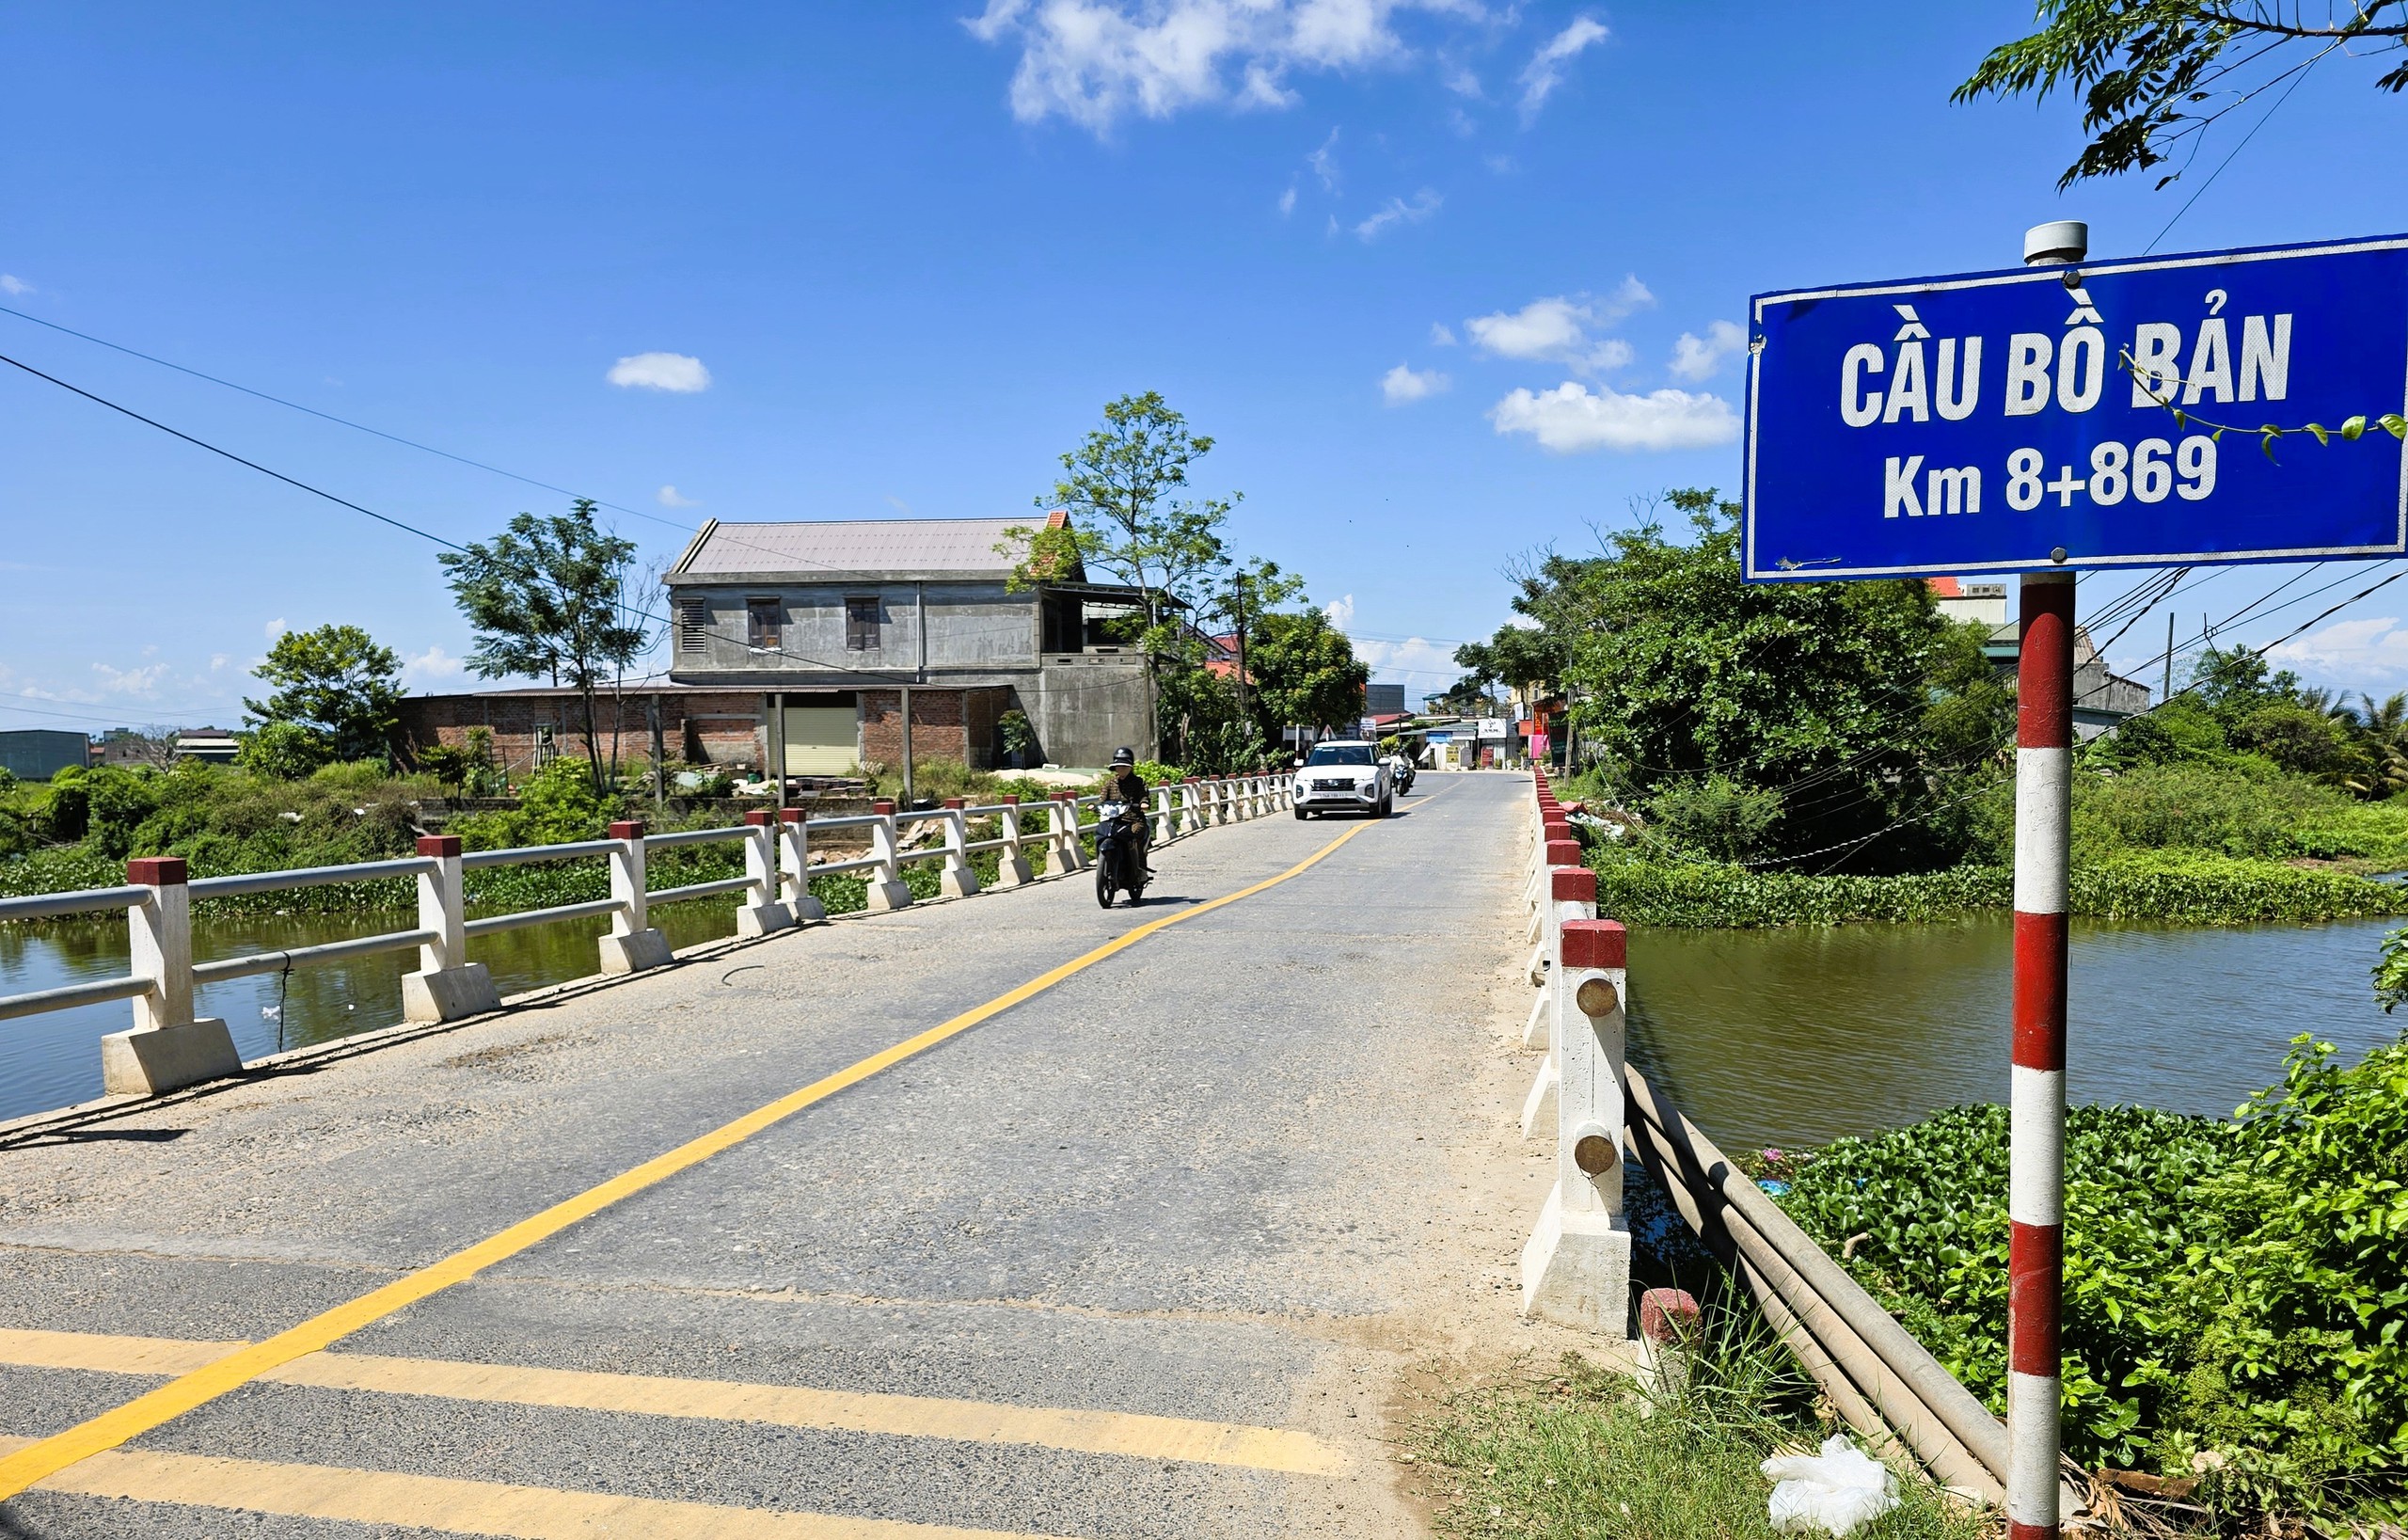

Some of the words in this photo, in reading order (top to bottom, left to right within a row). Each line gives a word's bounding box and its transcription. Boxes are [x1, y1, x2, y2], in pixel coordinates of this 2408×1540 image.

[1840, 304, 1983, 428] CẦU
[2004, 287, 2105, 417] BỒ
[2131, 288, 2293, 408] BẢN
[1884, 454, 1981, 518] Km
[2005, 435, 2217, 512] 8+869
